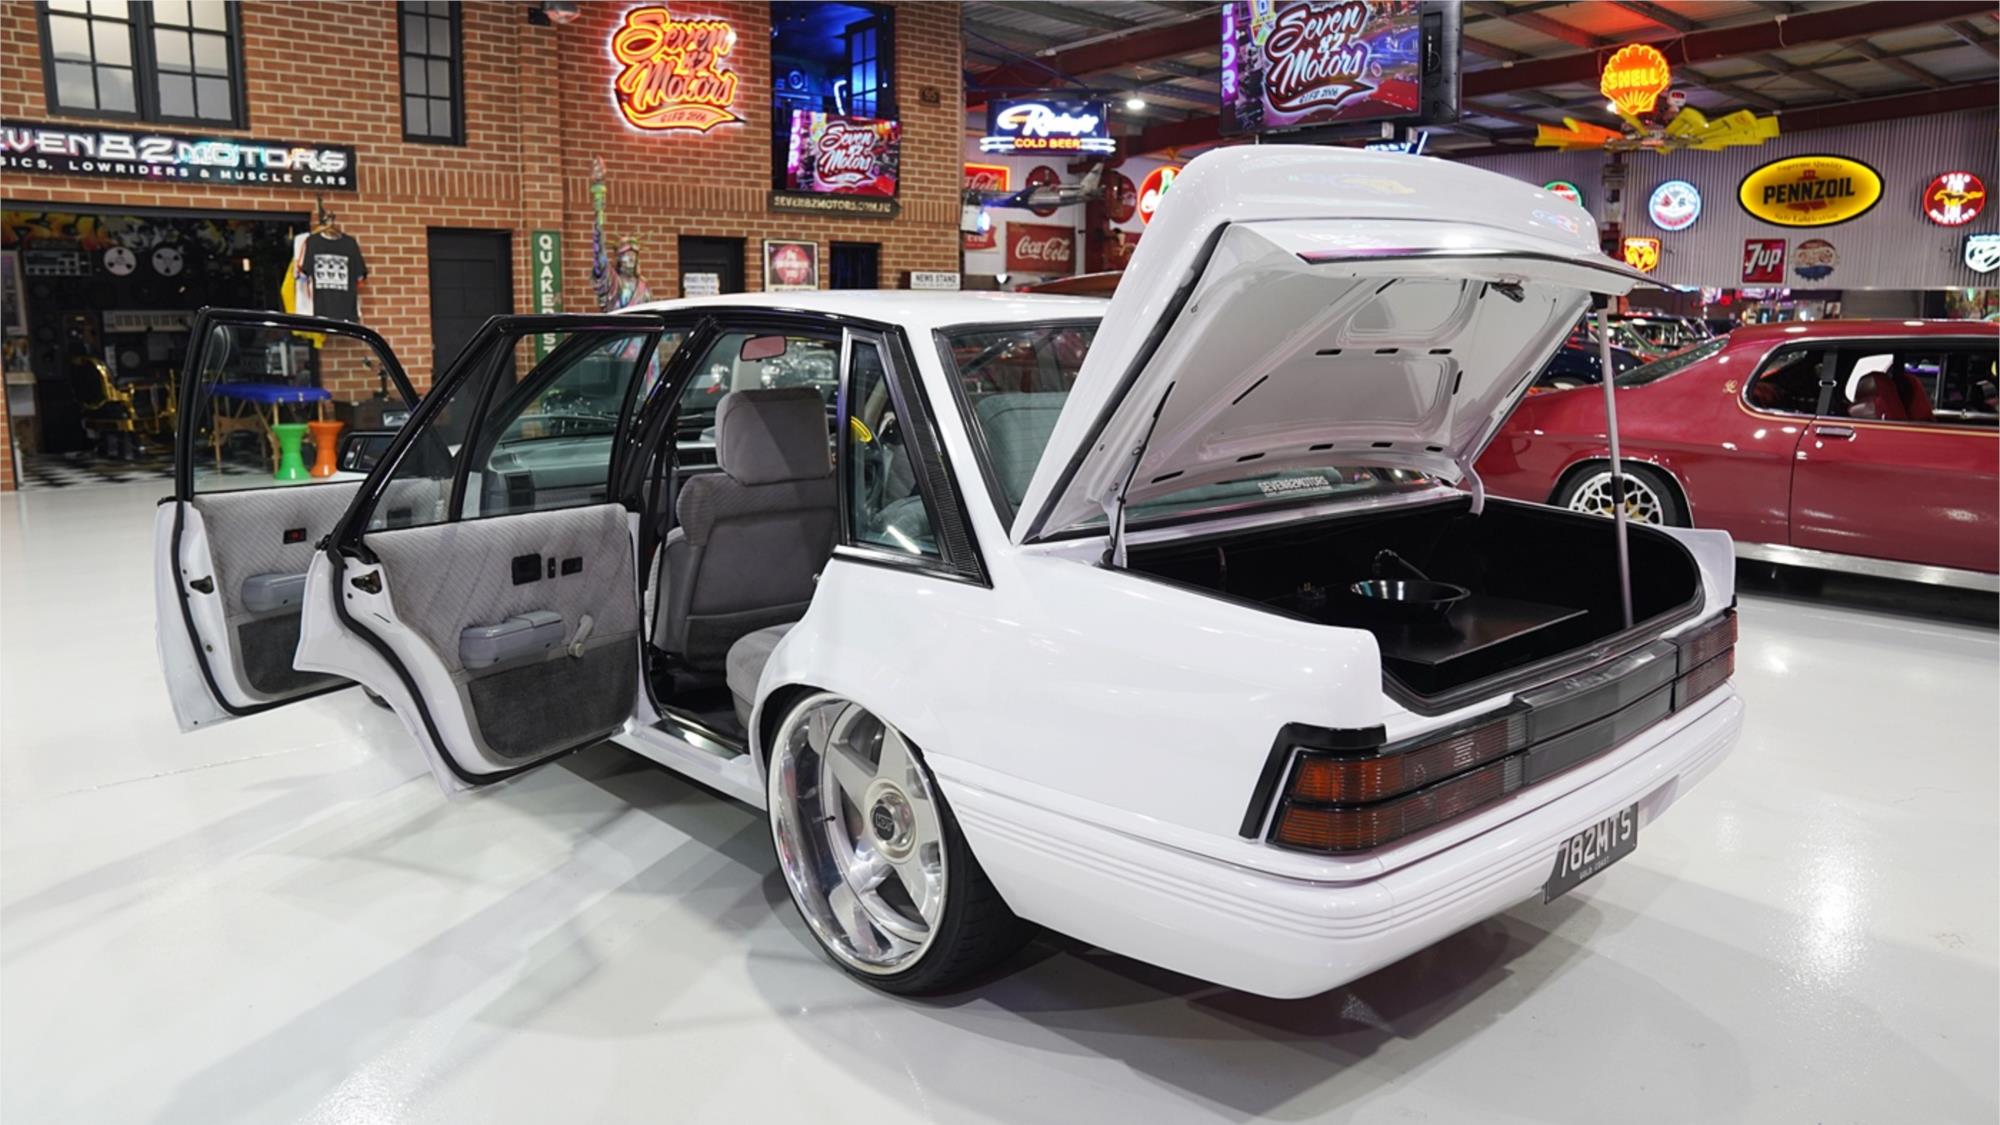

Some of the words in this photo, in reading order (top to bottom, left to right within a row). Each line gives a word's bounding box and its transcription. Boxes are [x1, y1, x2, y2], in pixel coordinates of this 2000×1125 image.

[616, 8, 732, 63] Seven
[1268, 4, 1362, 57] Seven
[1318, 33, 1346, 54] 82
[620, 59, 735, 110] Motors
[1270, 49, 1363, 95] Motors
[1607, 67, 1660, 90] SHELL
[0, 127, 348, 173] VEN82MOTORS
[819, 124, 873, 152] Seven
[1014, 137, 1047, 149] COLD
[1049, 137, 1081, 149] BEER
[69, 160, 189, 179] LOWRIDERS
[200, 169, 210, 178] &
[220, 170, 293, 184] MUSCLE
[302, 175, 347, 186] CARS
[819, 150, 872, 174] Motors
[1763, 177, 1856, 205] PENNZOIL
[935, 274, 957, 283] STAND
[1558, 806, 1632, 878] 782MTS
